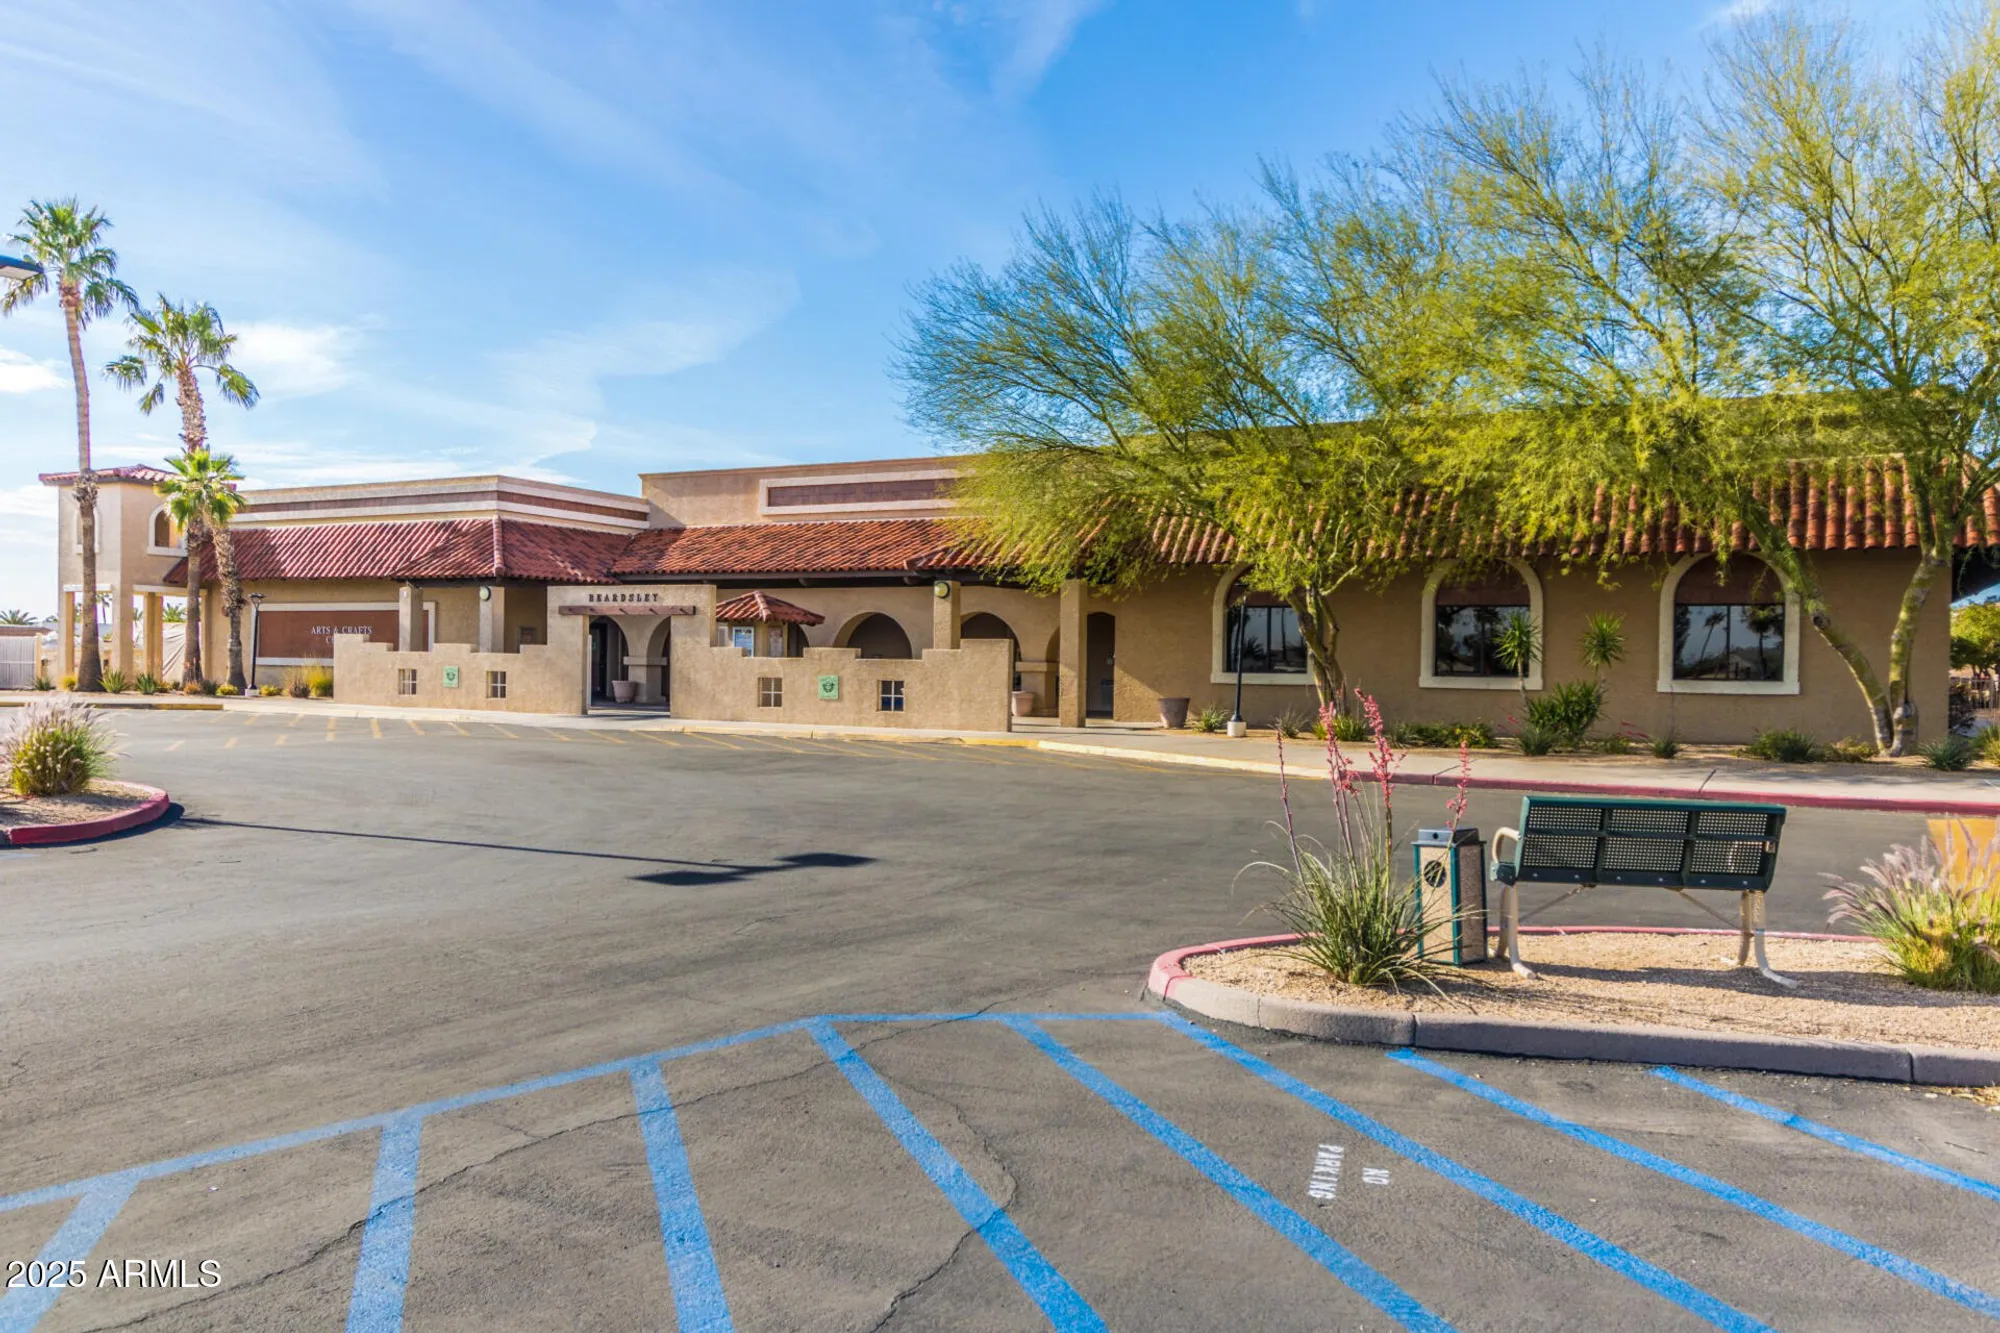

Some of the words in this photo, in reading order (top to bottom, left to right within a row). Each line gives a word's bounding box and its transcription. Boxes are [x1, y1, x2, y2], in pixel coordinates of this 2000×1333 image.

[588, 593, 659, 602] BEARDSLEY
[311, 625, 331, 635] ARTS
[333, 625, 339, 635] &
[341, 625, 373, 635] CRAFTS
[1307, 1144, 1345, 1200] PARKING
[1362, 1167, 1391, 1185] NO
